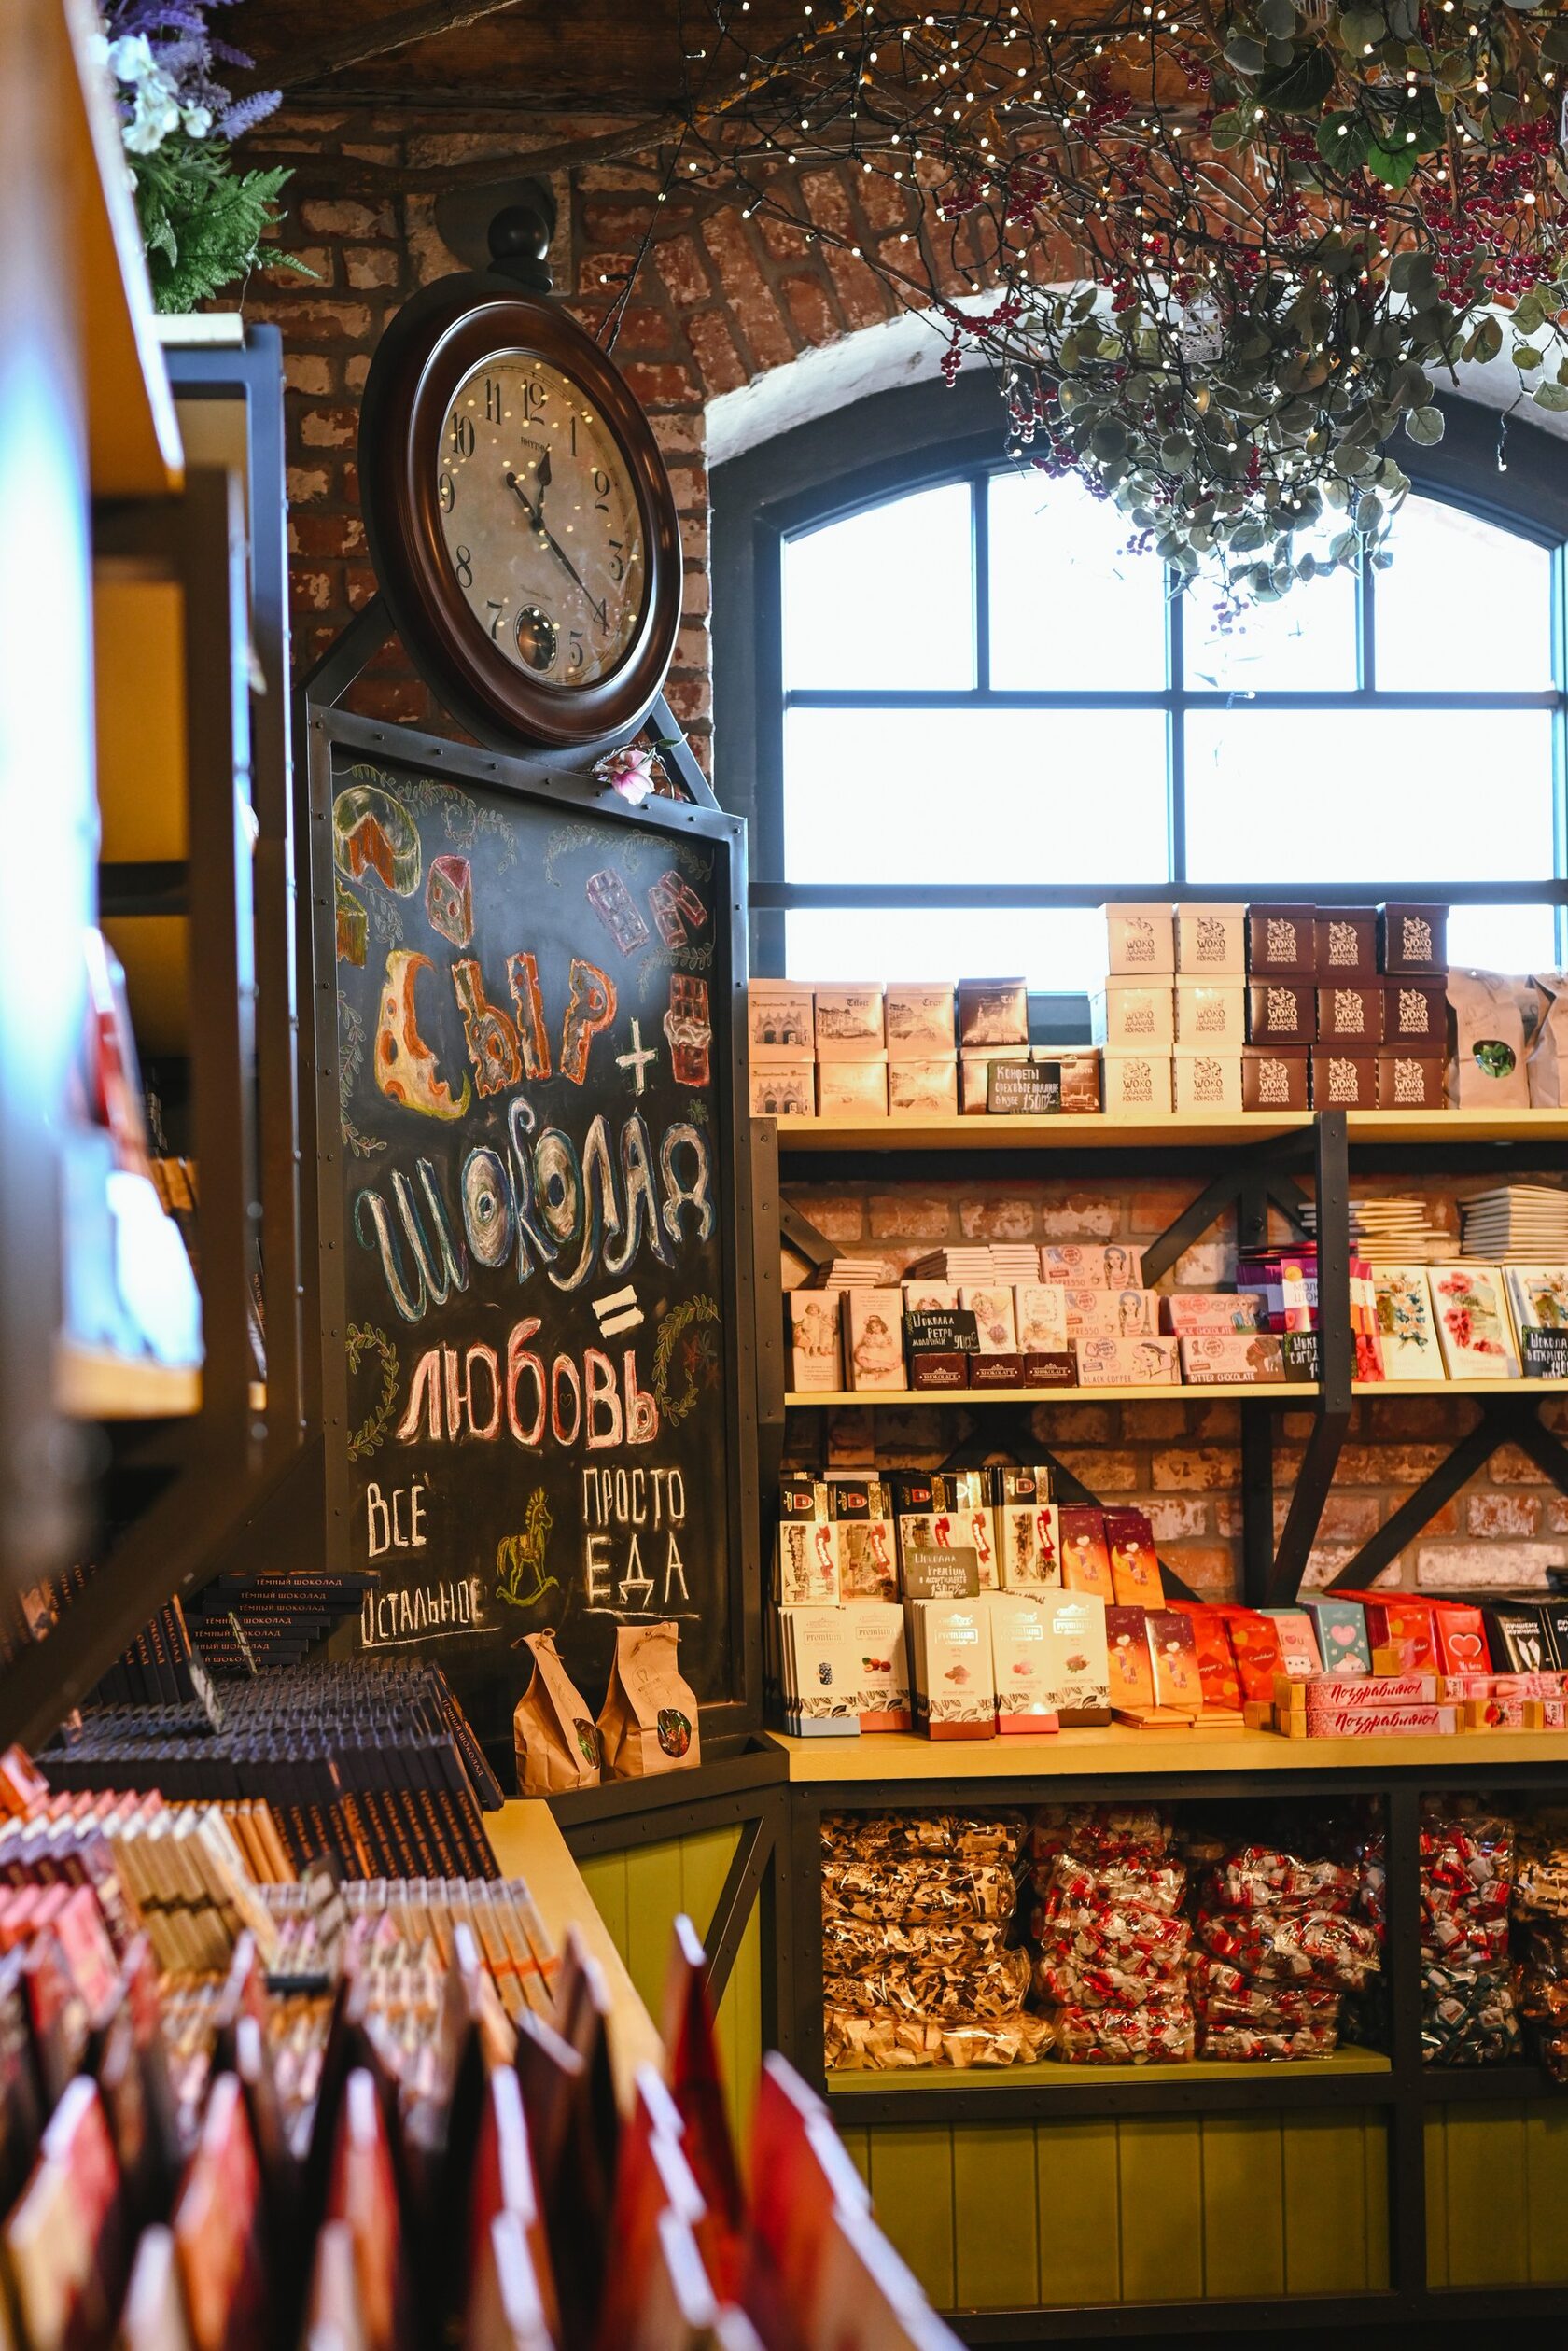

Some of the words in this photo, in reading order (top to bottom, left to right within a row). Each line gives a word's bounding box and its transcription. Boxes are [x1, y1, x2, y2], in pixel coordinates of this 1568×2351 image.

[484, 379, 501, 426] 11
[523, 379, 547, 426] 12
[451, 412, 475, 458] 10
[569, 416, 578, 457] 1
[439, 473, 456, 513] 9
[594, 471, 610, 512] 2
[455, 545, 473, 588] 8
[609, 539, 624, 581] 3
[486, 600, 503, 640] 7
[593, 598, 609, 637] 4
[569, 630, 584, 667] 5
[396, 1317, 659, 1450] ЛЮБОВЬ
[1217, 1373, 1255, 1381] CHOCOLATE
[582, 1468, 685, 1529] ПРОСТО
[587, 1532, 691, 1607] ЕДА
[149, 1619, 165, 1664] ОКОЛАД
[1330, 1681, 1422, 1705] Поздравляю!
[1335, 1711, 1439, 1735] Поздравляю!
[459, 1733, 483, 1777] ШОКОЛАД
